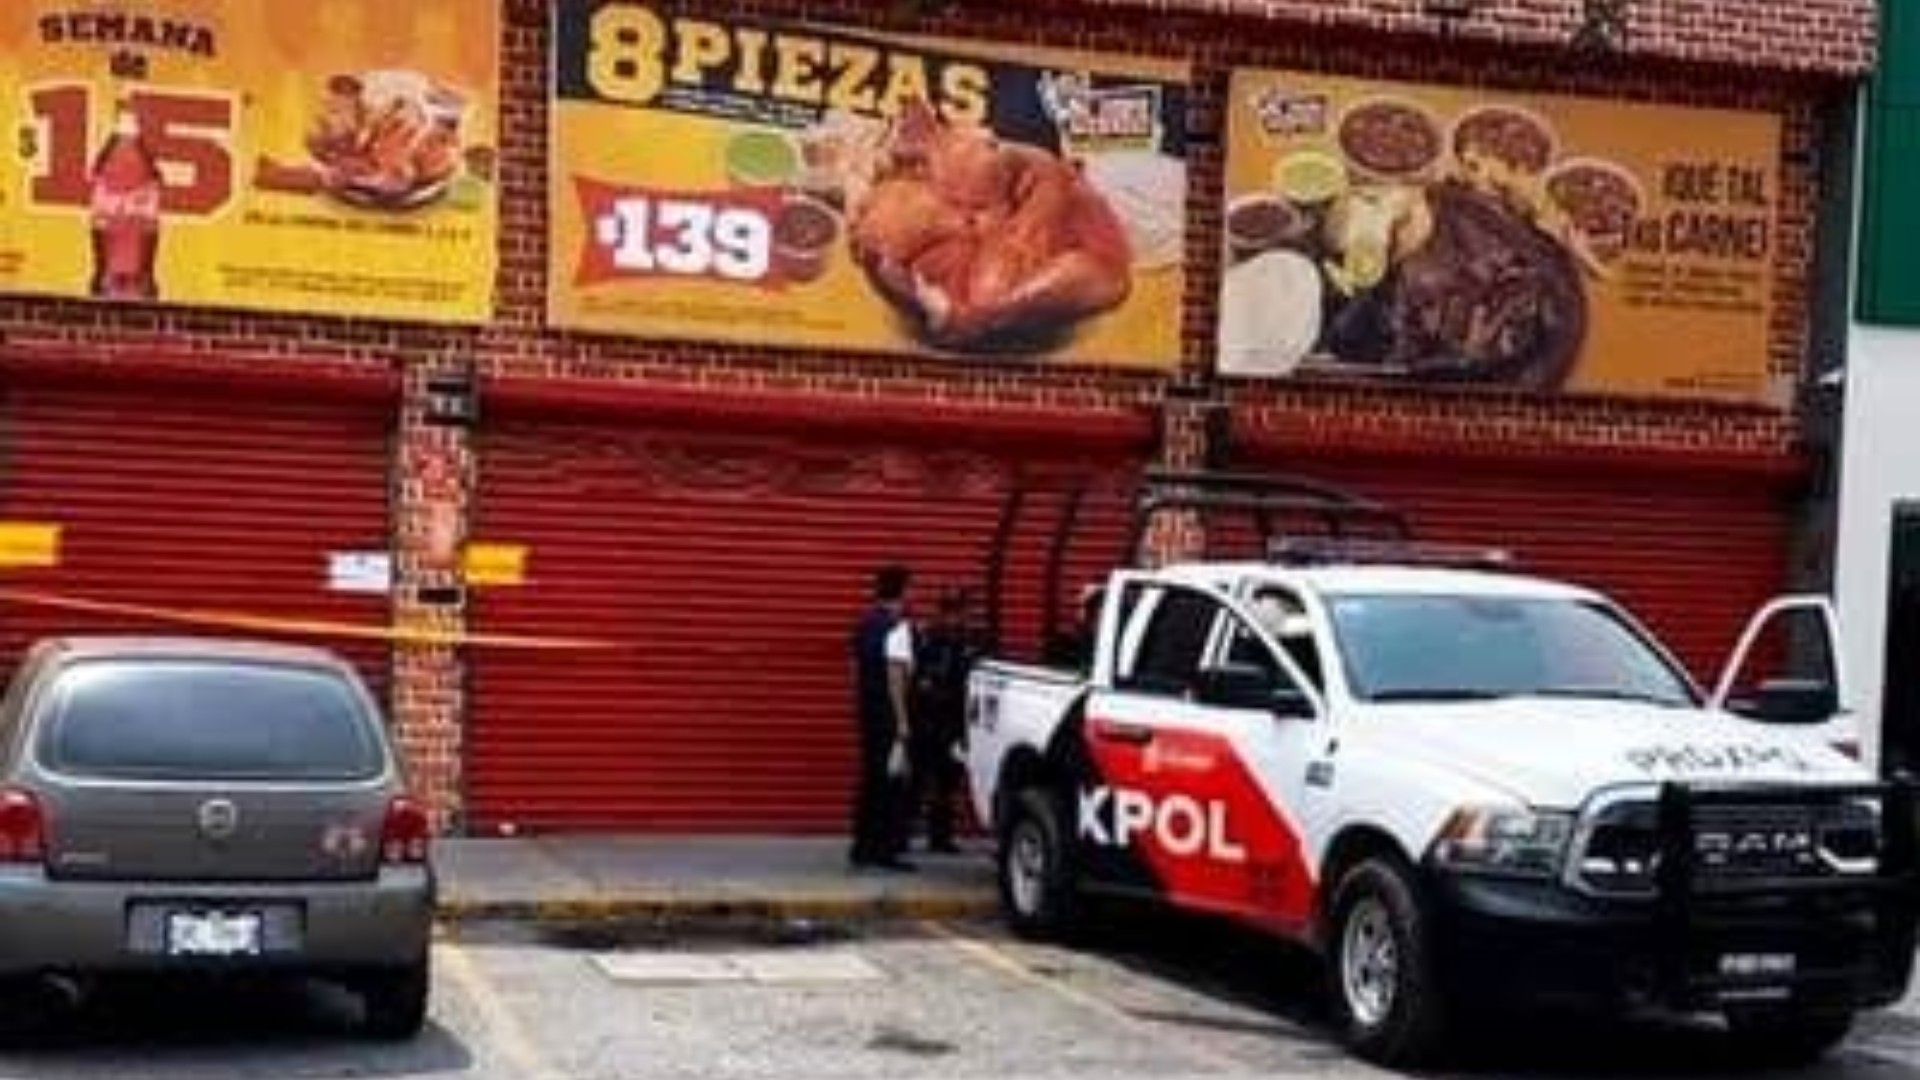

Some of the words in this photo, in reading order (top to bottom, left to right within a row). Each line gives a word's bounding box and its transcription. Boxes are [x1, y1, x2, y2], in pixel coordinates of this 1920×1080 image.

[39, 12, 217, 57] SEMANA
[586, 3, 665, 103] 8
[670, 18, 990, 122] PIEZAS
[1694, 831, 1815, 864] RAM
